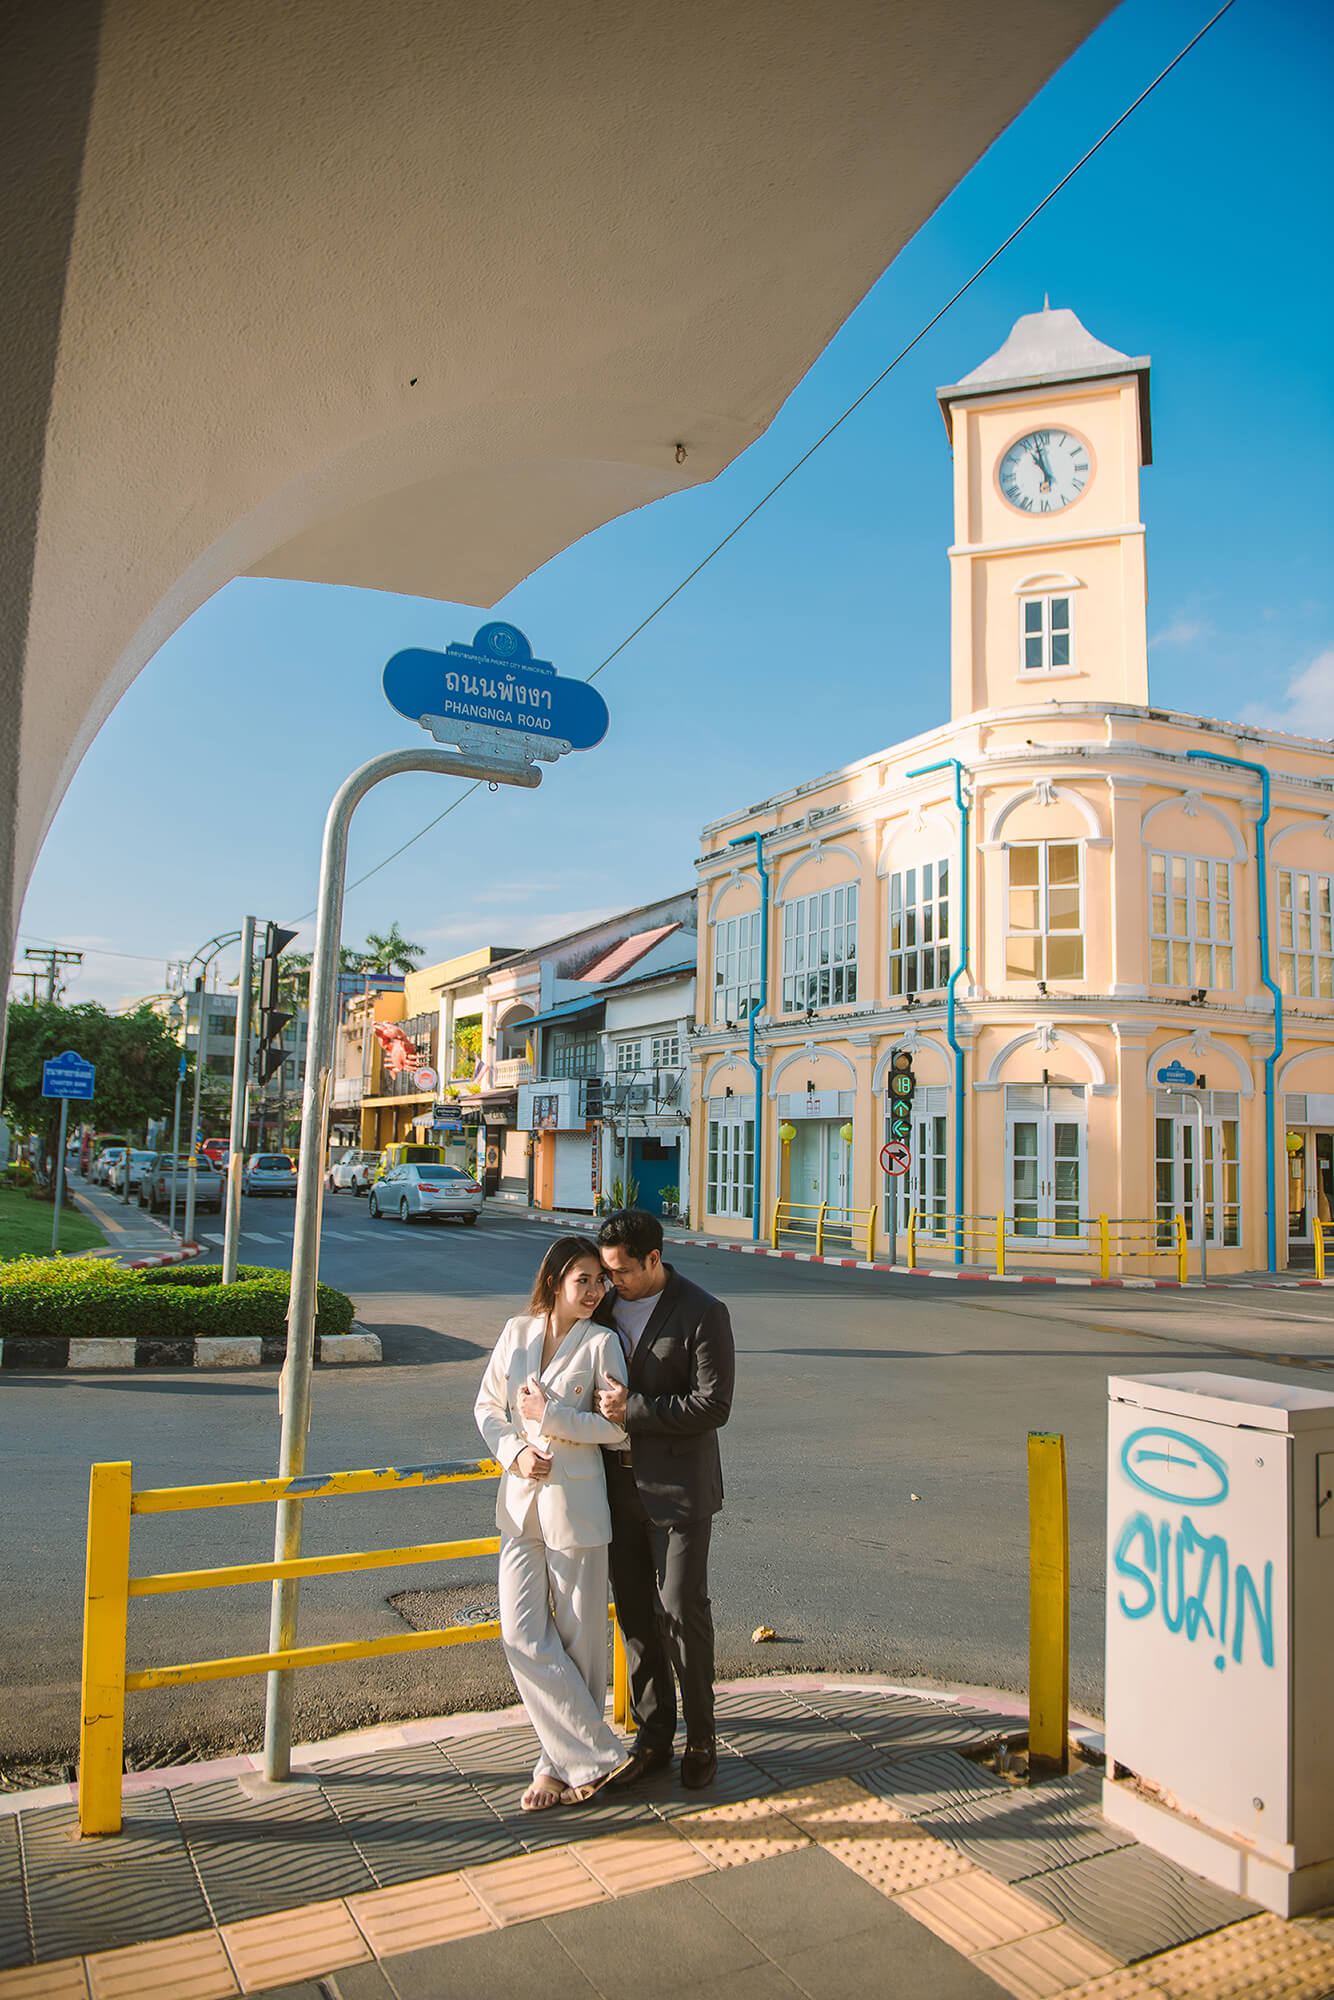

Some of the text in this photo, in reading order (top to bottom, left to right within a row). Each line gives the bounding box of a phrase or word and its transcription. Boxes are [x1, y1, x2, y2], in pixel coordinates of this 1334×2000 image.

[445, 671, 552, 710] ถนนพังงา
[444, 700, 552, 730] PHANGNGA ROAD
[897, 1077, 910, 1093] 18
